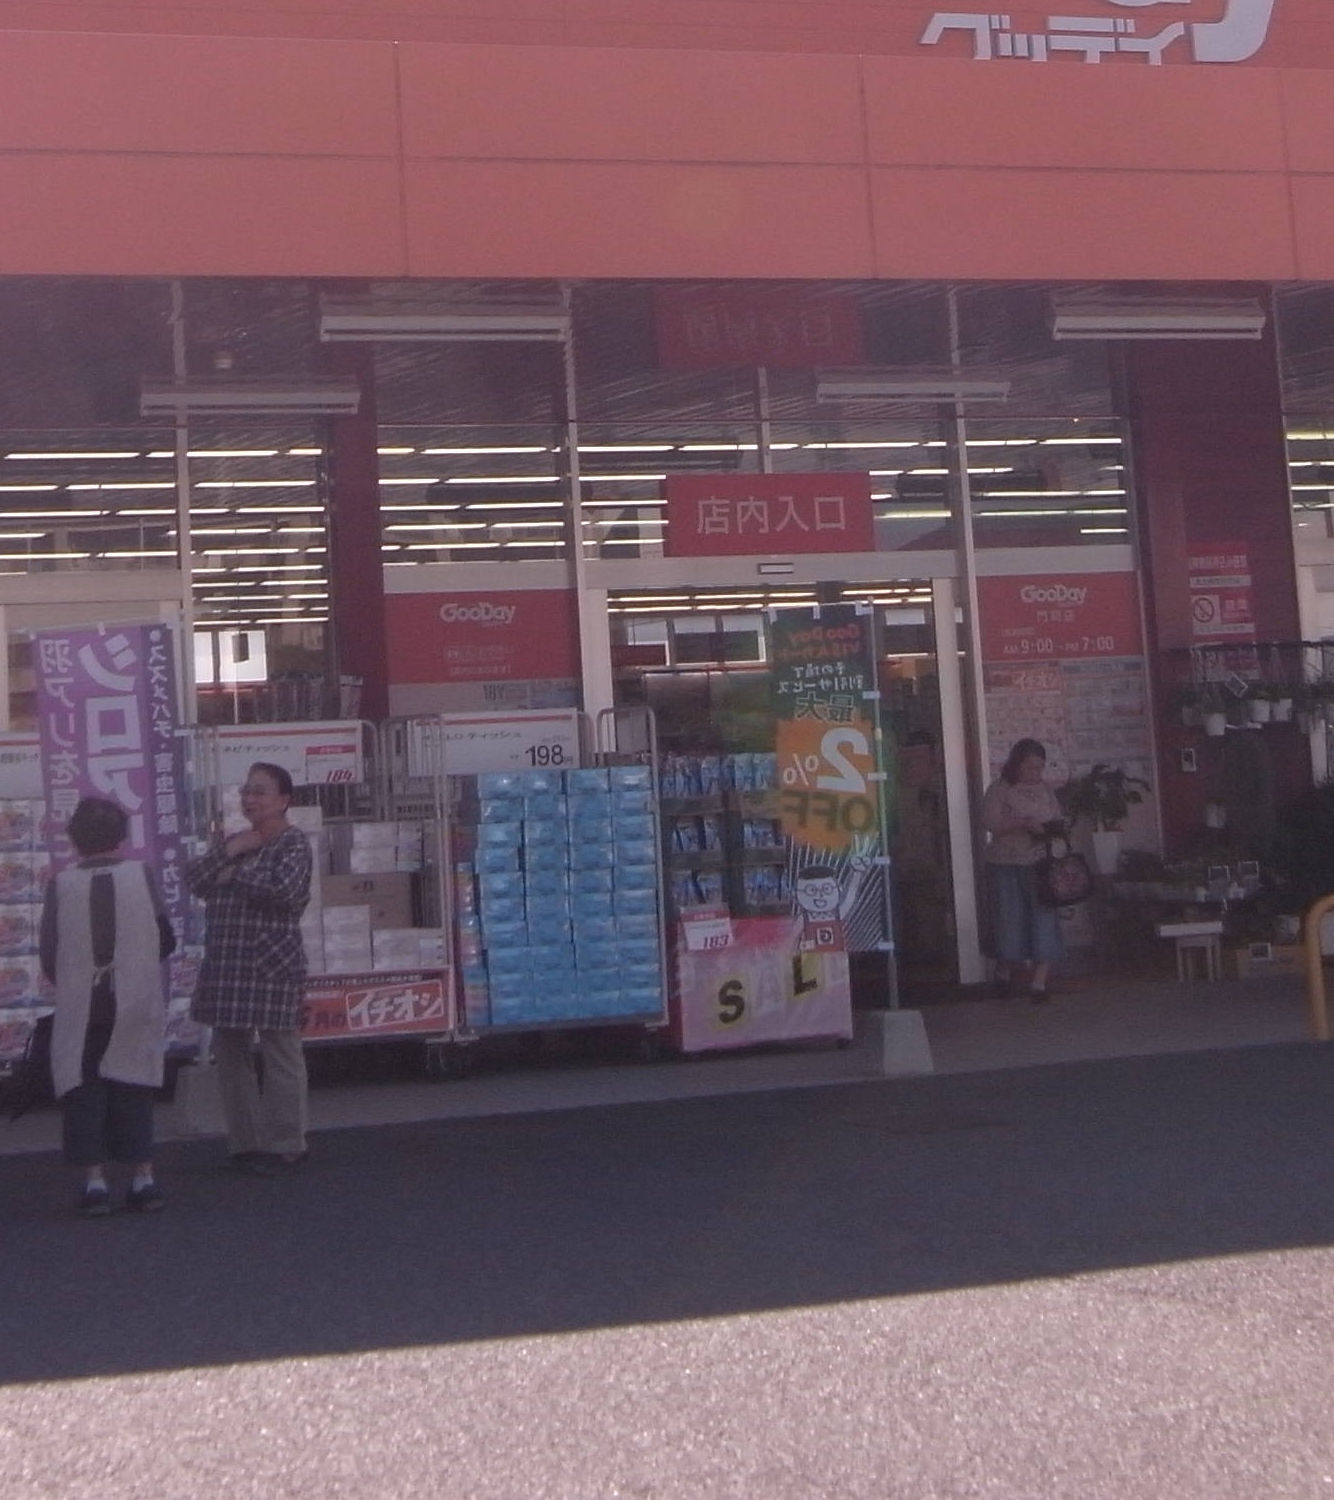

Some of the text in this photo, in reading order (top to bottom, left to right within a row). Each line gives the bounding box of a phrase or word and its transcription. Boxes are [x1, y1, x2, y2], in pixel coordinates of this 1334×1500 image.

[697, 496, 846, 534] 店内入口
[1020, 585, 1087, 605] GooDay
[440, 602, 515, 624] GooDay
[1021, 638, 1054, 654] 9:00
[1081, 635, 1115, 651] 7:00
[350, 988, 443, 1029] イチオシ
